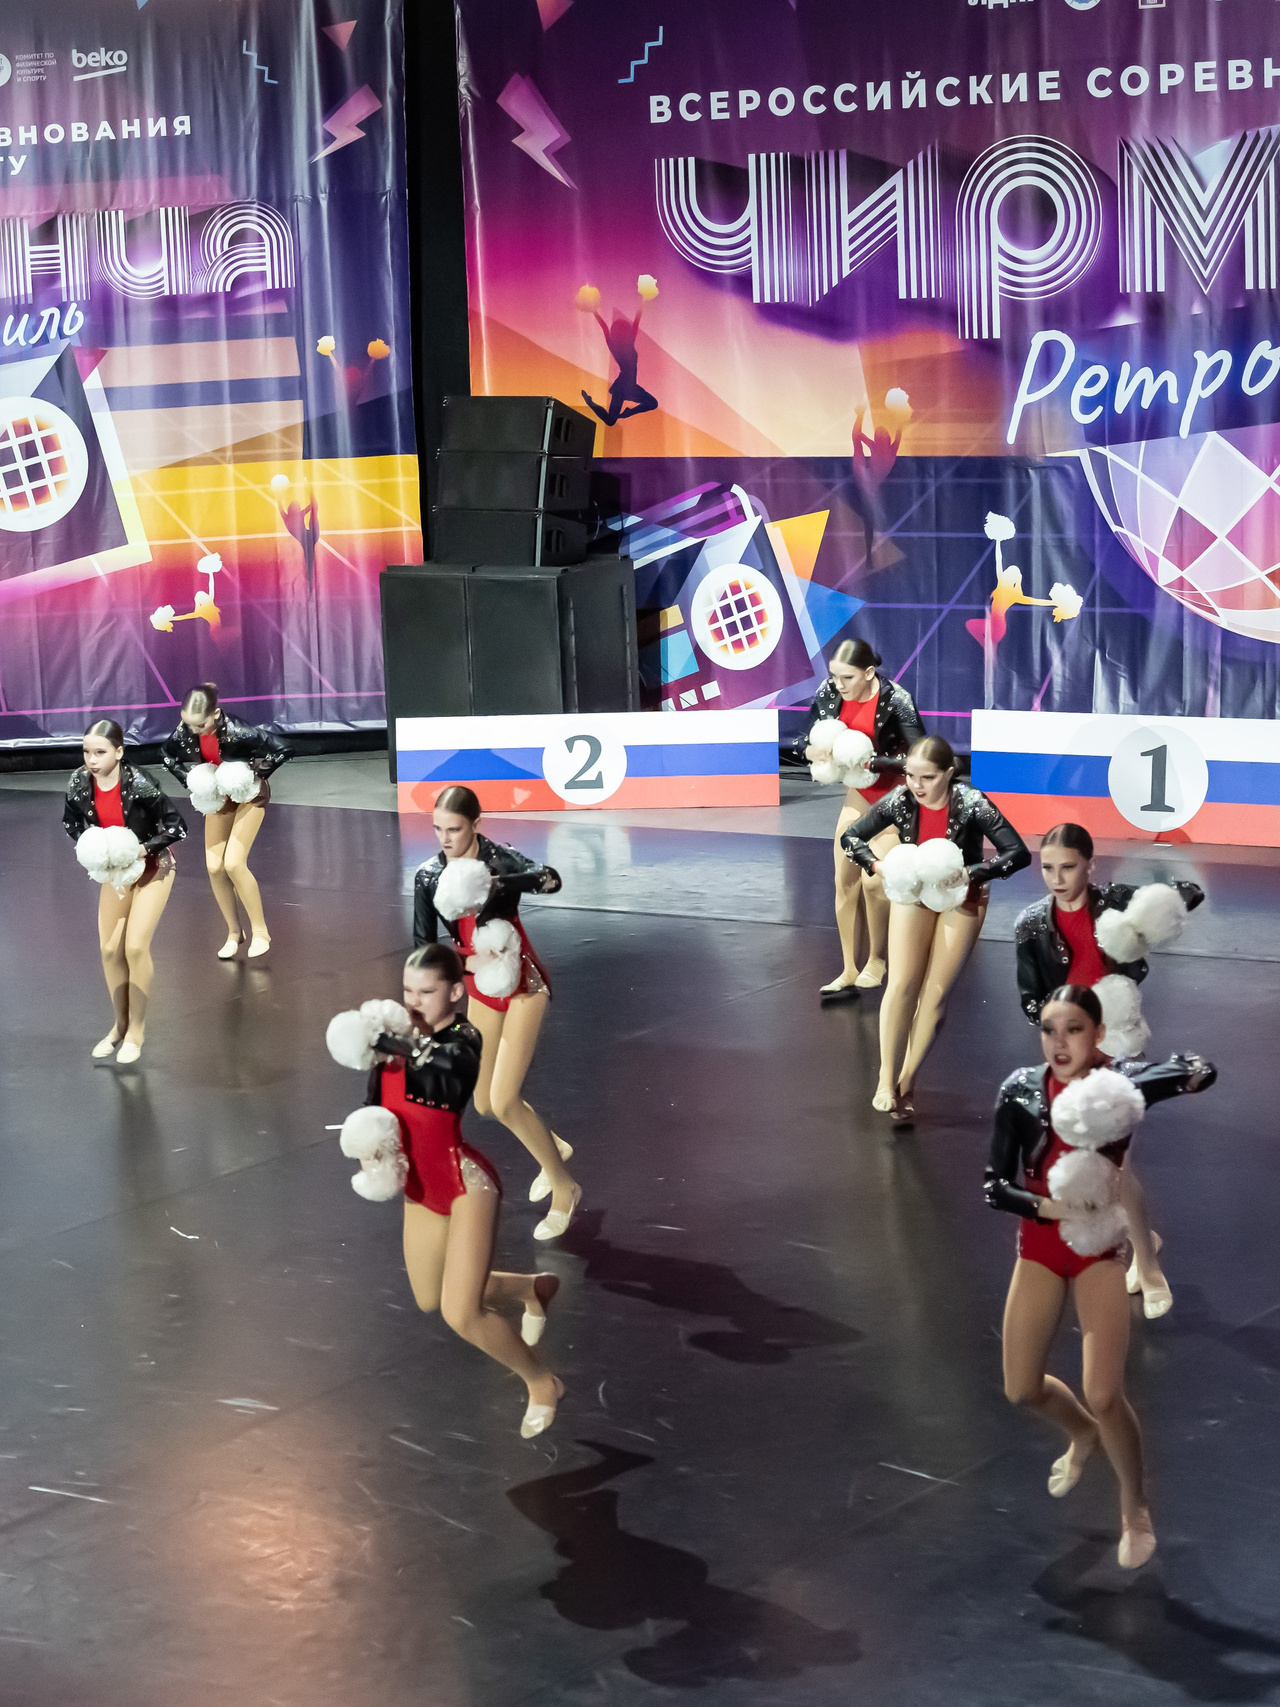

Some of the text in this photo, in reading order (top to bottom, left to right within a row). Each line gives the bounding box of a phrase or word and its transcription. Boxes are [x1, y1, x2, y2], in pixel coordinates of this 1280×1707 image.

[72, 47, 128, 68] beko
[650, 70, 1061, 123] ВСЕРОССИЙСКИЕ
[1007, 330, 1280, 444] Ретро
[565, 735, 604, 789] 2
[1140, 745, 1175, 812] 1
